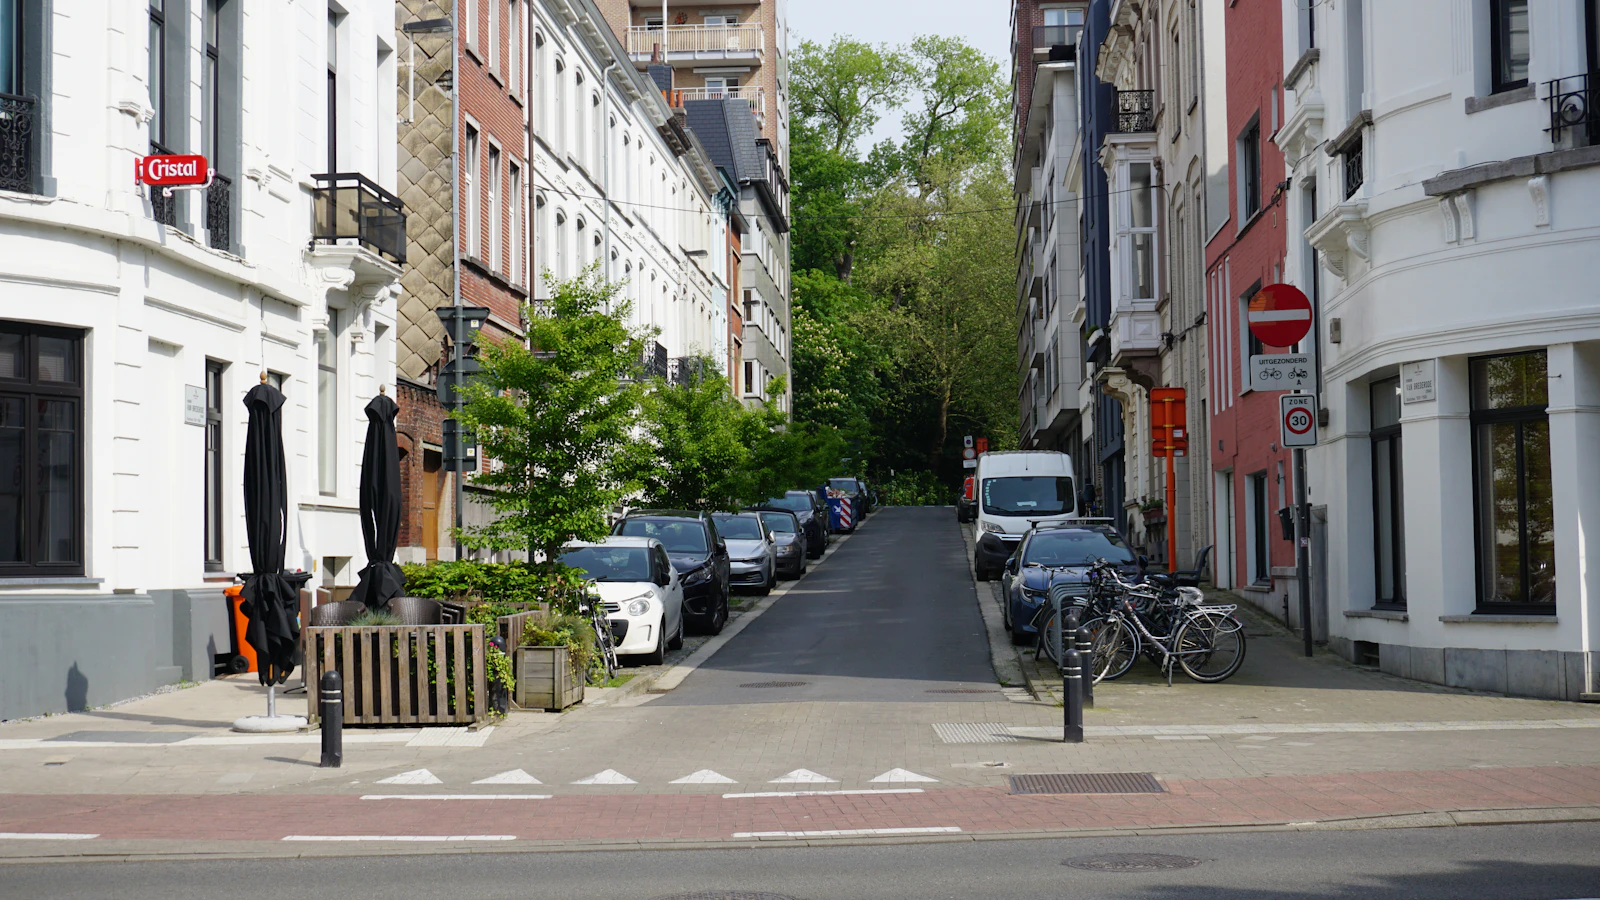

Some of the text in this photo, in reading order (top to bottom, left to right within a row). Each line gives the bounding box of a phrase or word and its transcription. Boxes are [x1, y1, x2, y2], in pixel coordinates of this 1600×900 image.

[148, 159, 197, 181] Cristal
[1258, 357, 1308, 365] UITGEZONDERD
[1291, 415, 1307, 426] 30
